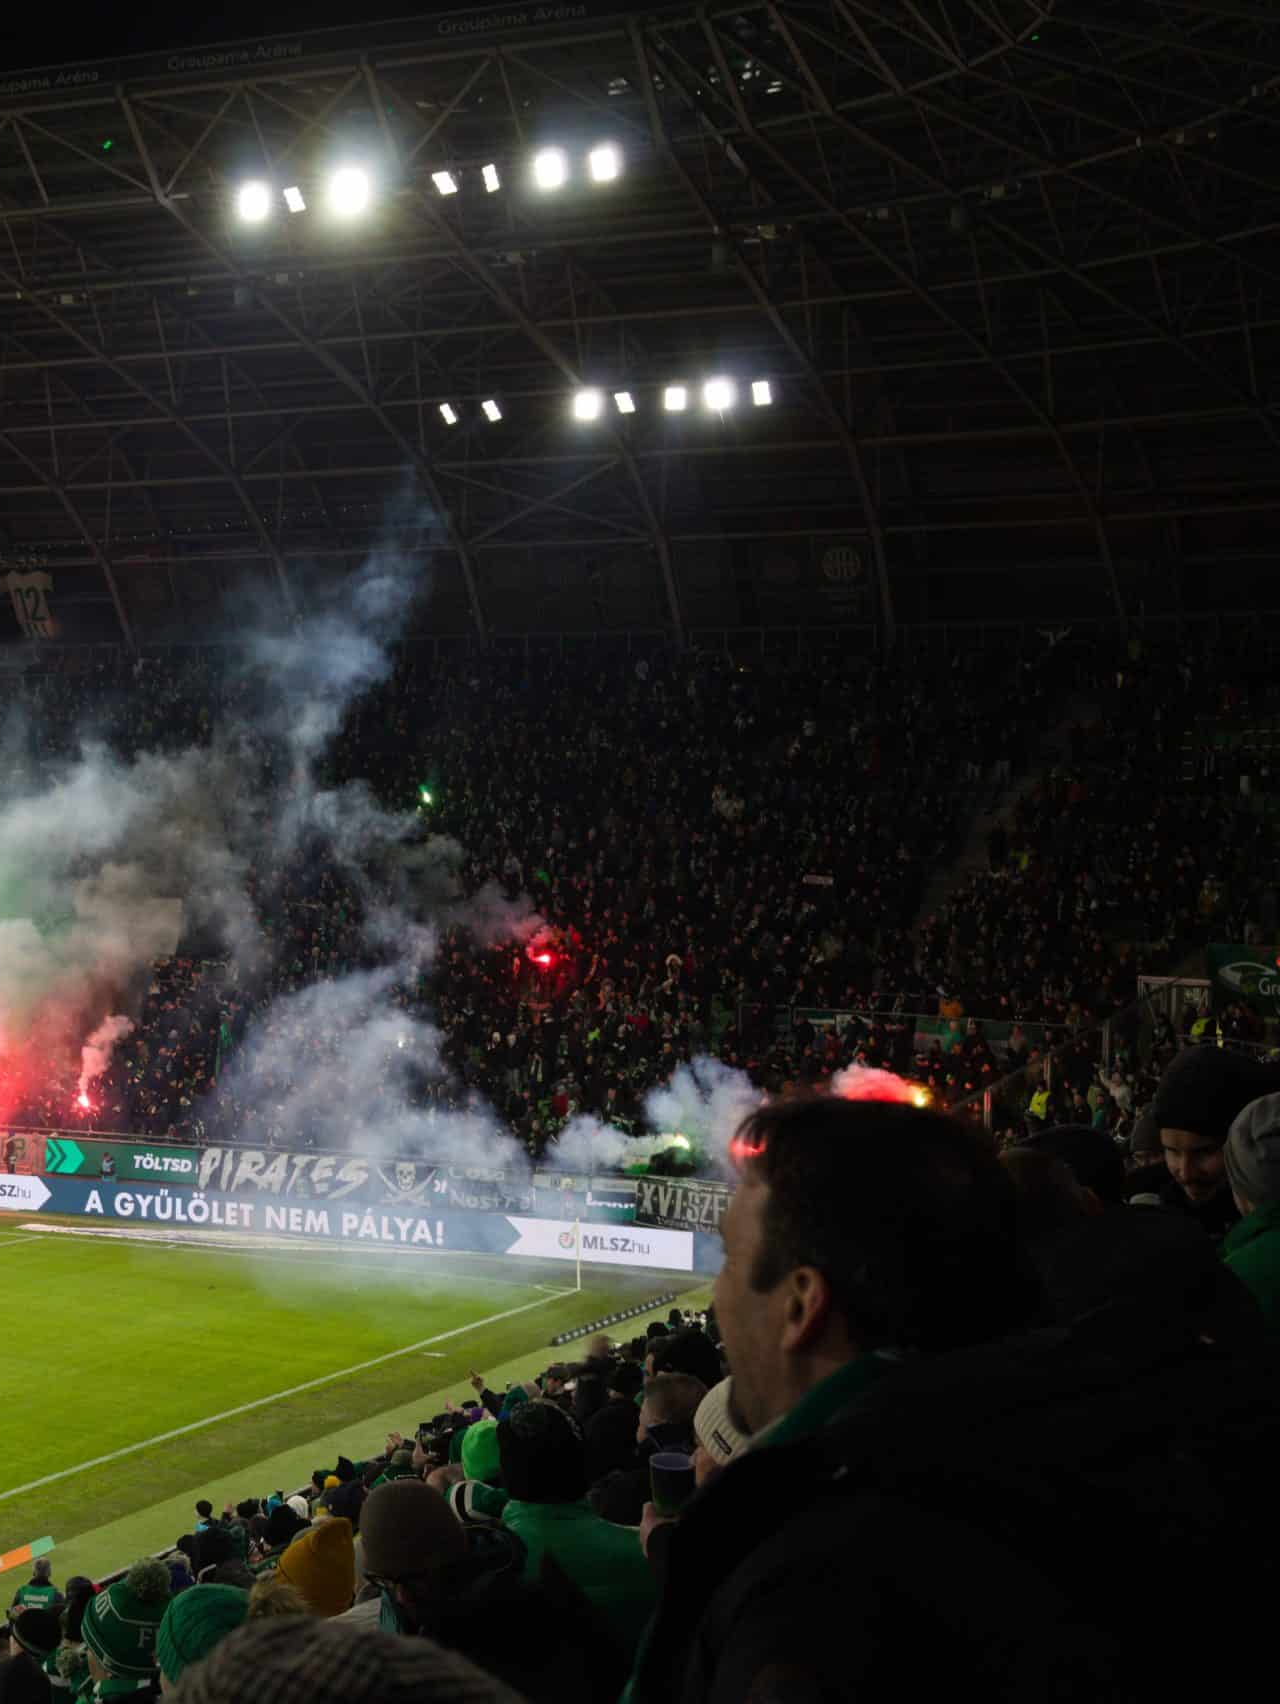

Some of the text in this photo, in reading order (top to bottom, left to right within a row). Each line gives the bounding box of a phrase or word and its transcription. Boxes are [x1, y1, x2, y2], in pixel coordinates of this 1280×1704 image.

[133, 1153, 192, 1173] TÖLTSD
[198, 1147, 369, 1200] PIRATES
[84, 1188, 444, 1246] A GYŰLÖLET NEM PÁLYA!
[582, 1234, 650, 1255] MLSZ.hu
